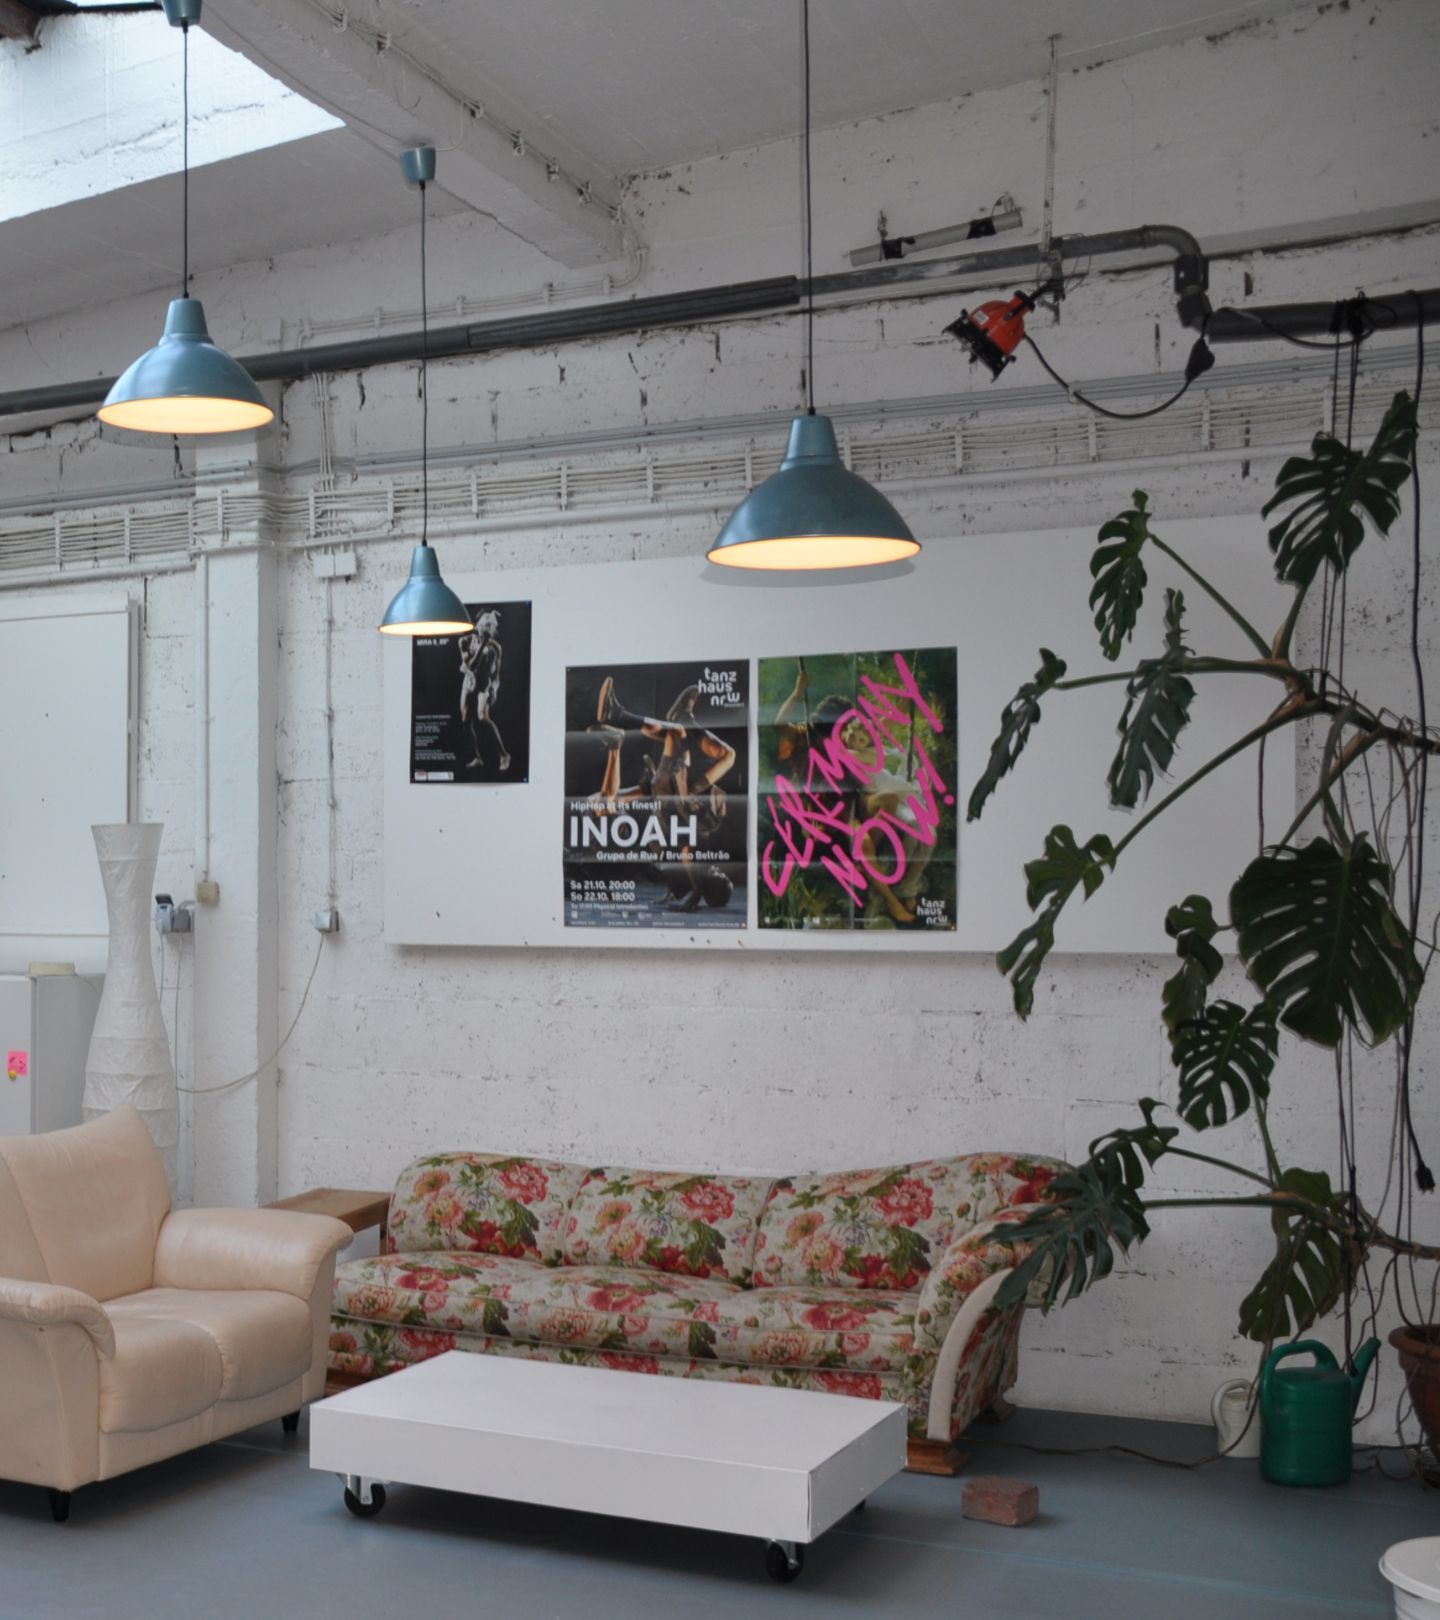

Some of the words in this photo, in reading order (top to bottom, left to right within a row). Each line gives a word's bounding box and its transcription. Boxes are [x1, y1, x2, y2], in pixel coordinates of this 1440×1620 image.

[704, 666, 737, 682] tanz
[698, 679, 733, 693] haus
[710, 691, 740, 706] nrw
[570, 801, 605, 813] HipHop
[618, 800, 630, 811] its
[632, 800, 661, 811] finest!
[821, 736, 954, 908] NOW!
[570, 815, 697, 847] INOAH
[596, 851, 624, 862] Grupo
[627, 851, 638, 861] de
[640, 851, 658, 861] Rua
[666, 851, 693, 860] Bruno
[695, 850, 730, 860] Beltrão
[570, 880, 582, 890] Sa
[583, 880, 607, 890] 21.10.
[609, 880, 636, 890] 20:00
[570, 892, 583, 901] So
[584, 892, 609, 901] 22.10.
[611, 892, 636, 901] 18:00
[921, 897, 945, 908] tanz
[916, 904, 942, 916] haus
[926, 914, 948, 925] nrw
